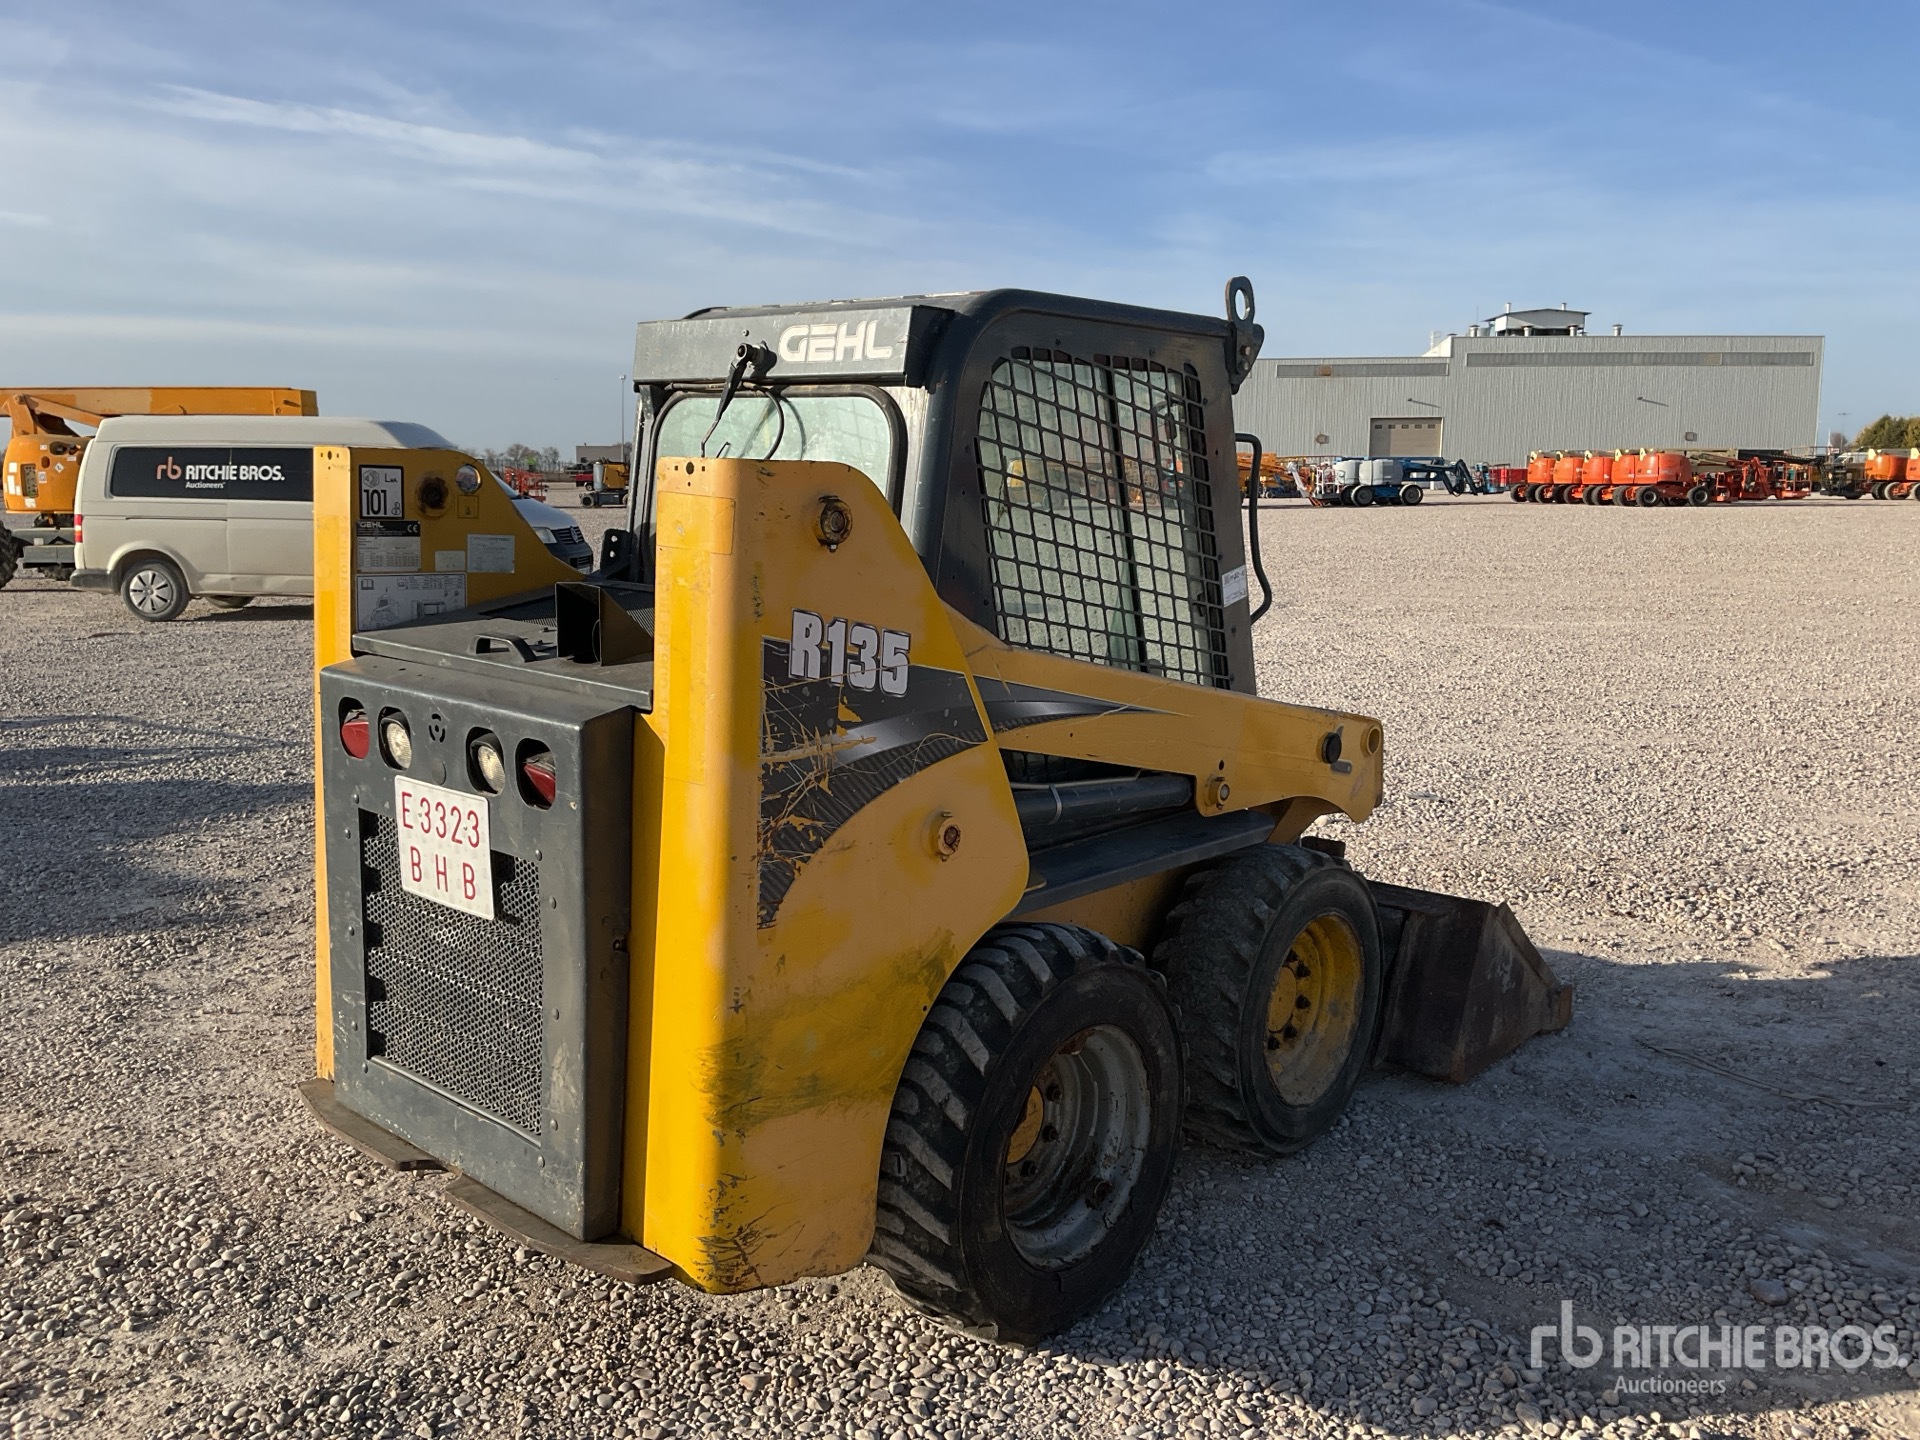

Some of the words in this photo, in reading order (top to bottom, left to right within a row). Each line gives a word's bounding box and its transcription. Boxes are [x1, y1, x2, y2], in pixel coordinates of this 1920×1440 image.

[778, 319, 893, 363] GEHL
[156, 456, 182, 480] rb
[185, 465, 238, 481] RITCHIE
[239, 465, 286, 481] BROS.
[363, 489, 388, 516] 101
[788, 608, 912, 698] R135
